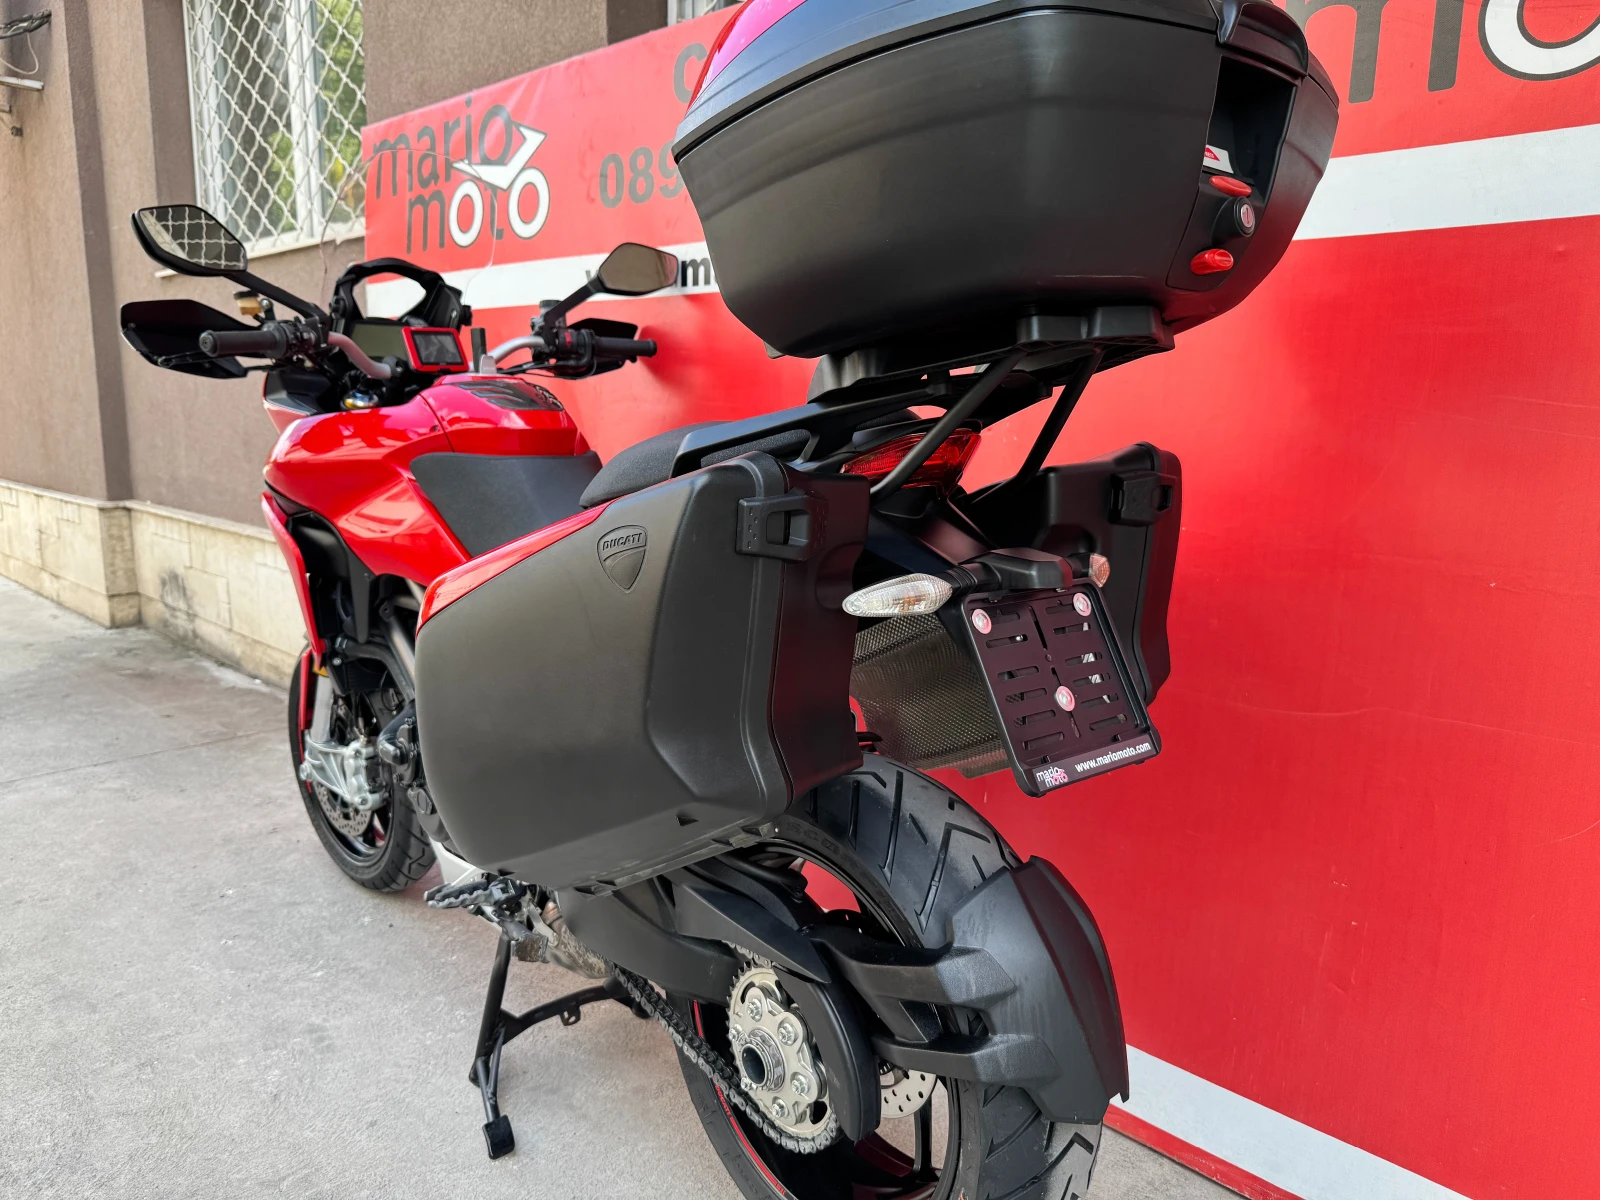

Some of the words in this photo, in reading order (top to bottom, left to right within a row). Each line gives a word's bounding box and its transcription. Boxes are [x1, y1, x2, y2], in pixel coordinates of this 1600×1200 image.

[373, 95, 513, 199] mario
[407, 167, 550, 254] moto
[603, 533, 642, 551] DUCATI
[1075, 742, 1151, 773] www.mariomoto.com
[1036, 766, 1060, 782] mario
